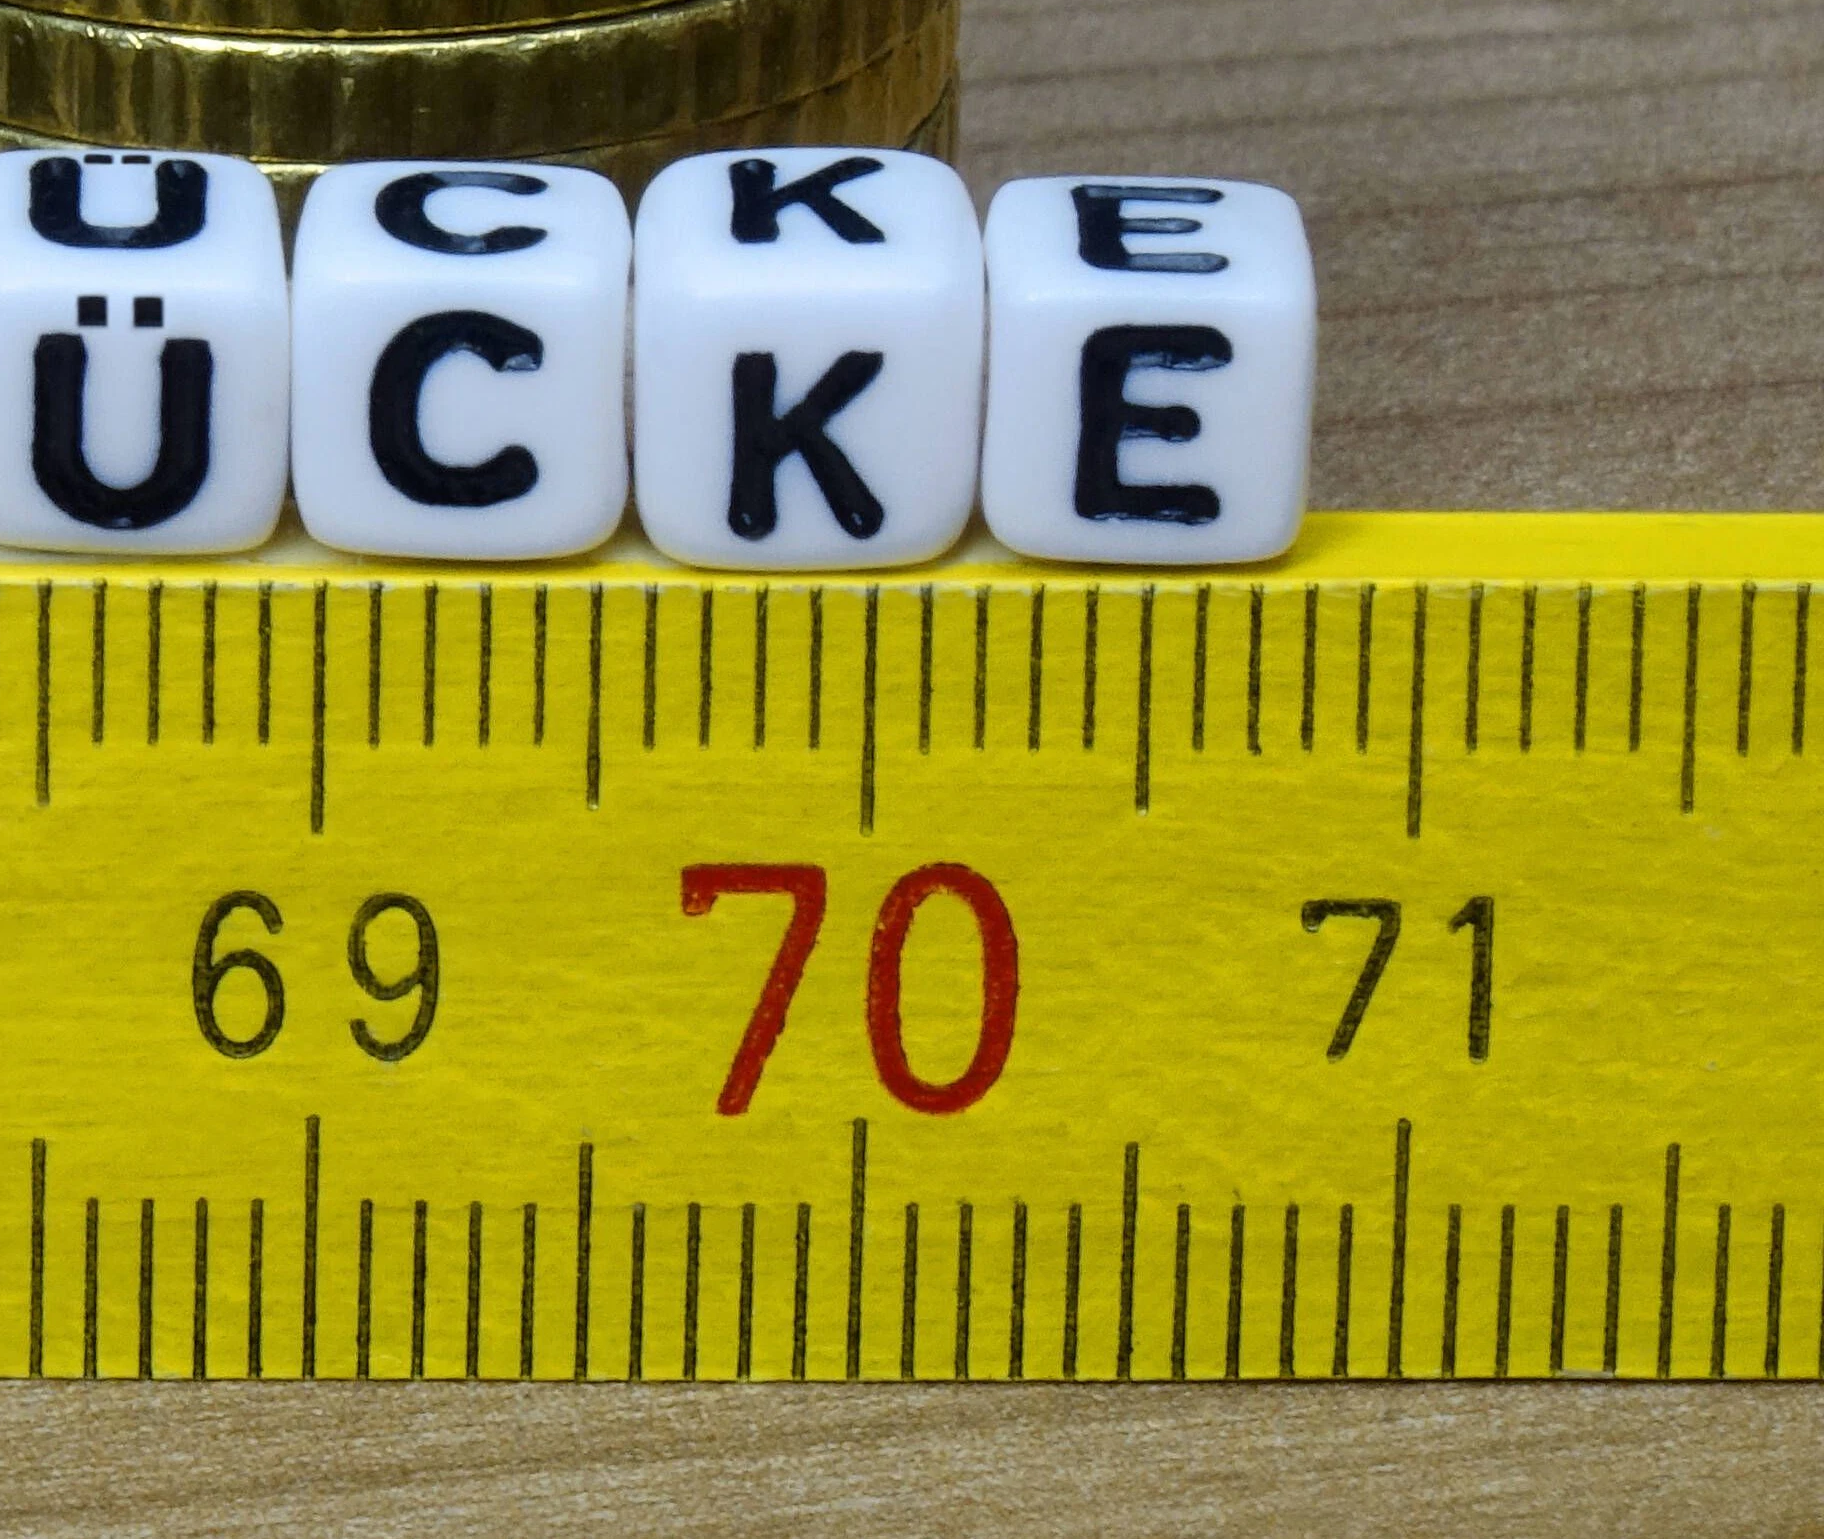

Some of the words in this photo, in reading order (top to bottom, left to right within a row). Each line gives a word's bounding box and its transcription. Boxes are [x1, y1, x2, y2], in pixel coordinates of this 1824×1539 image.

[192, 891, 439, 1061] 69
[681, 862, 1020, 1116] 70
[1301, 896, 1494, 1059] 71
